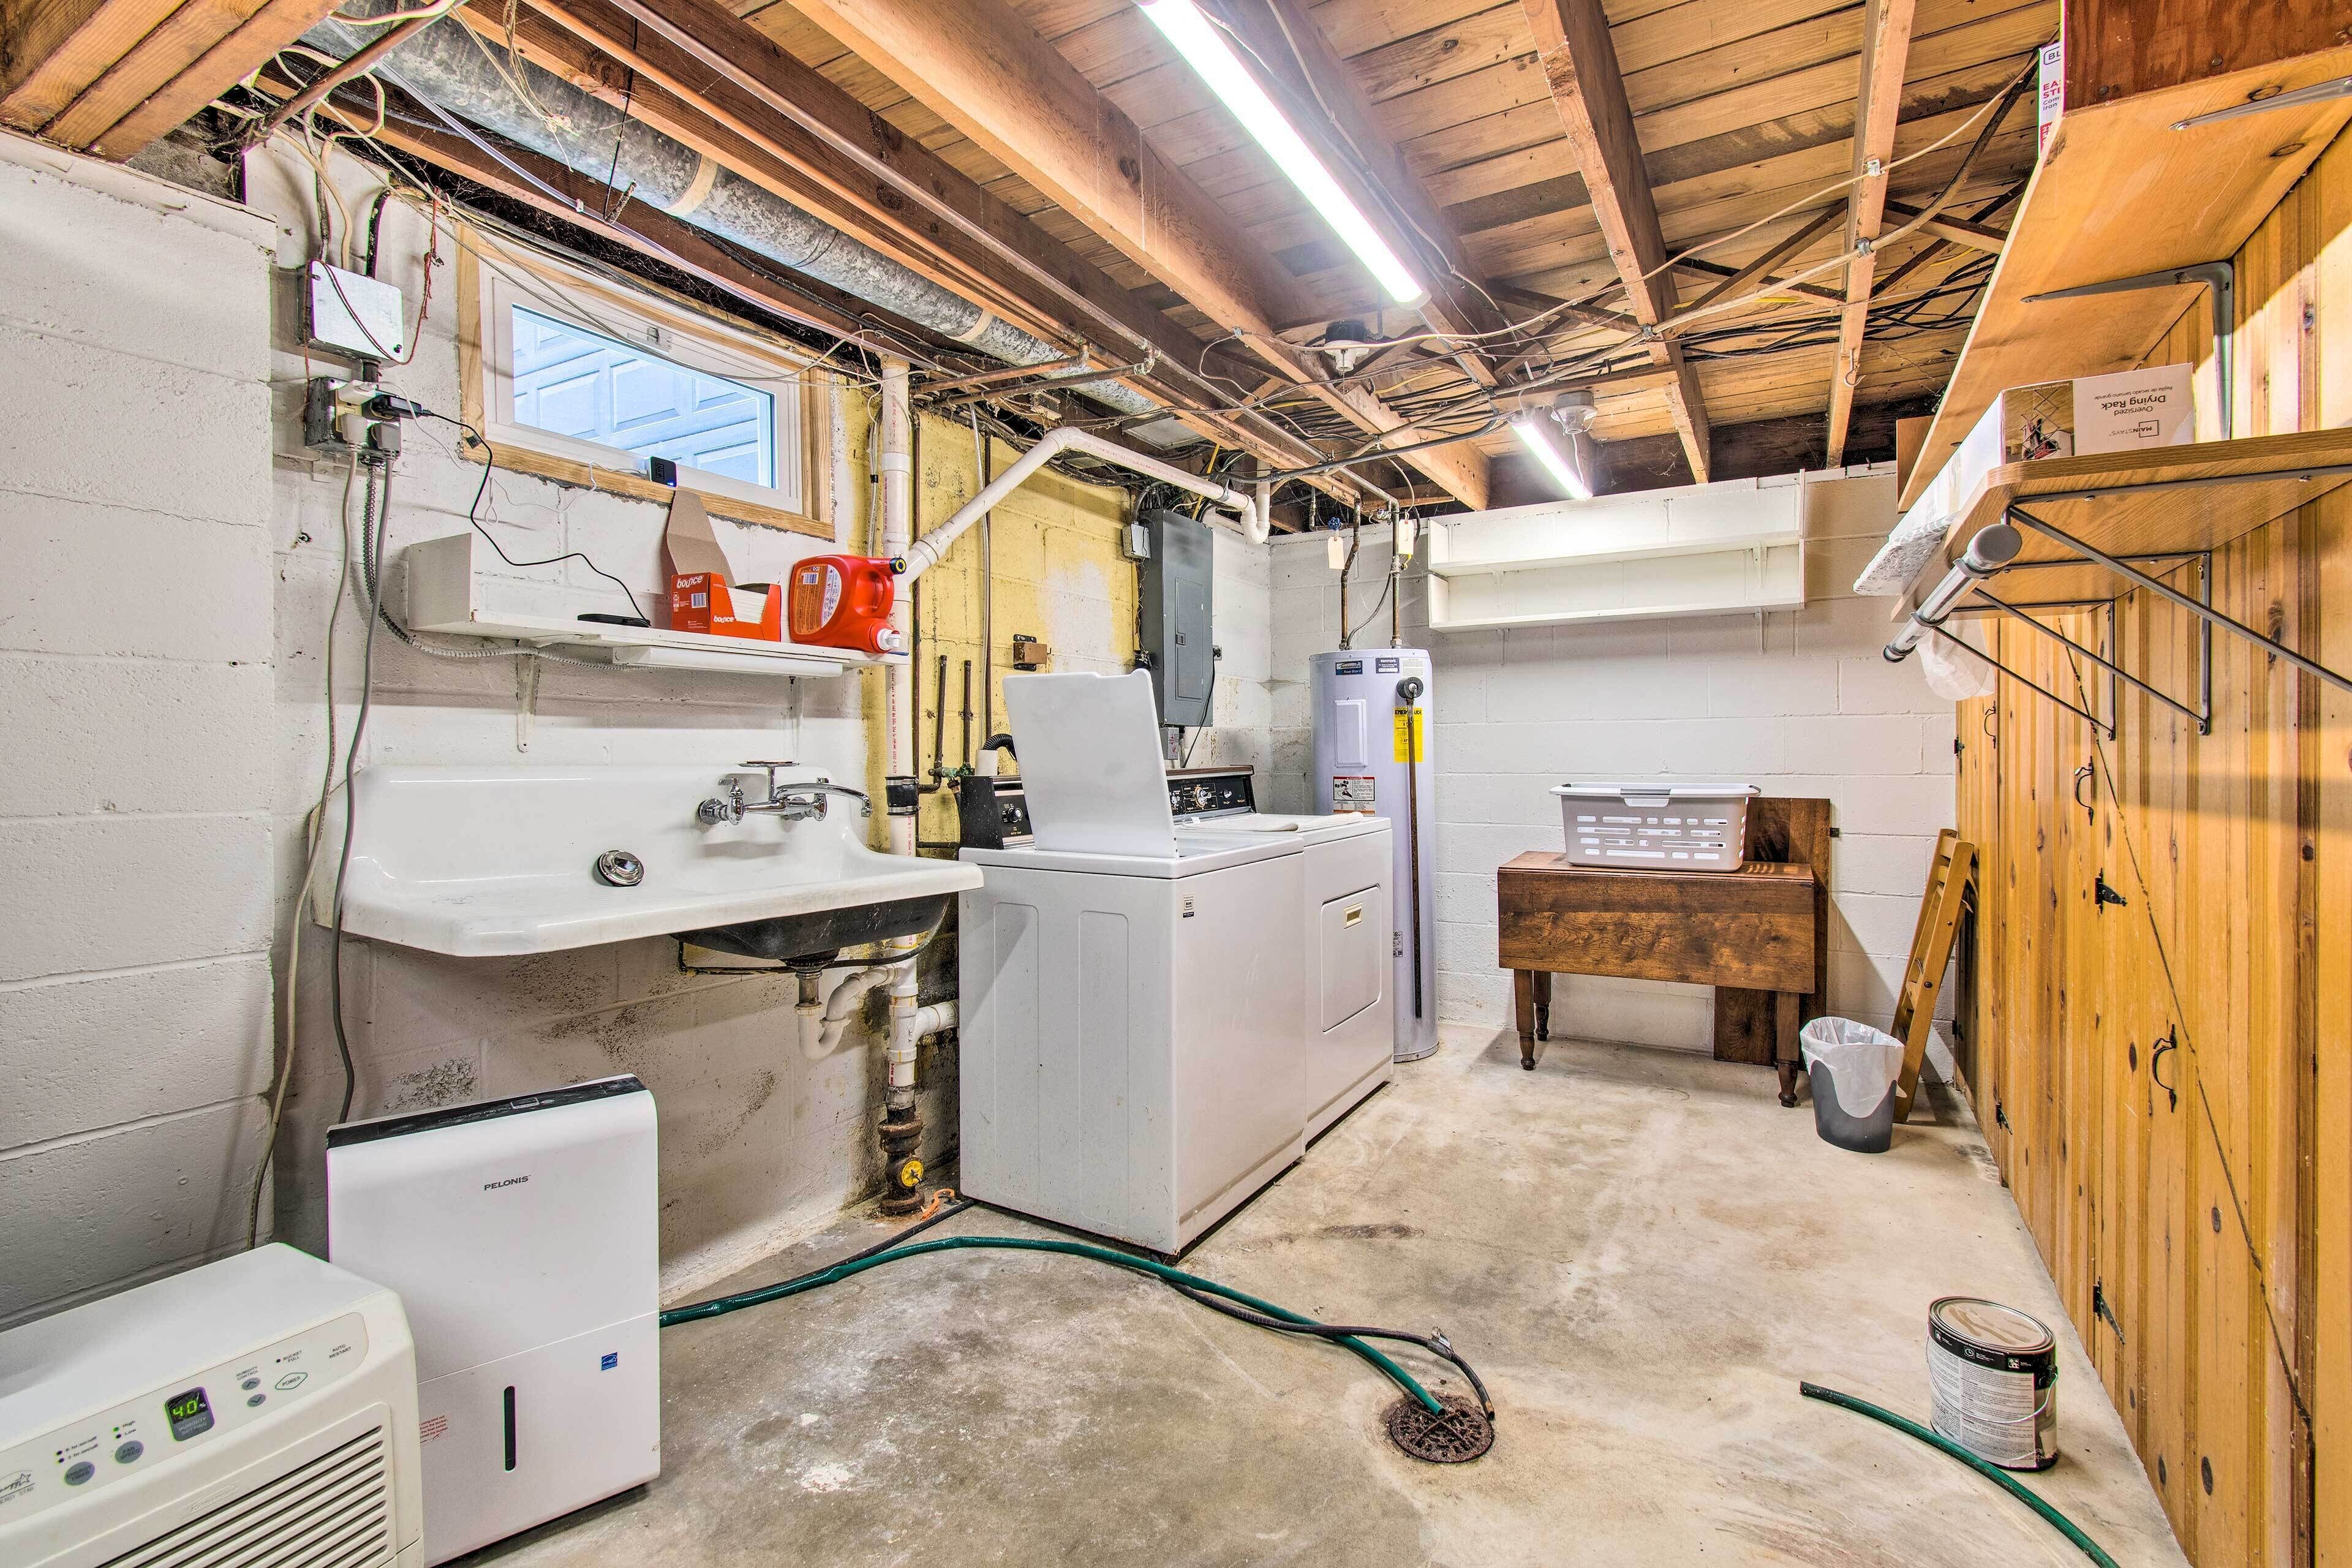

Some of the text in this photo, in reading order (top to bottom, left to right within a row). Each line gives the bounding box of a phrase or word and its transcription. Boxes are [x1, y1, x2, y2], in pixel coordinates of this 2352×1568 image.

[2043, 80, 2060, 91] EA
[2101, 394, 2166, 411] Drying Rack
[2114, 405, 2153, 417] Oversized
[676, 575, 704, 589] bounce
[713, 615, 734, 624] bounce
[484, 1176, 529, 1191] PELONIS
[283, 1350, 303, 1362] BUCKET
[329, 1346, 352, 1359] RESTART
[236, 1366, 258, 1378] HUMIDITY
[237, 1370, 259, 1381] CONTROL
[282, 1376, 301, 1387] POWER
[172, 1400, 197, 1417] 40
[178, 1417, 207, 1431] HUMIDITY
[19, 1487, 34, 1496] STAR
